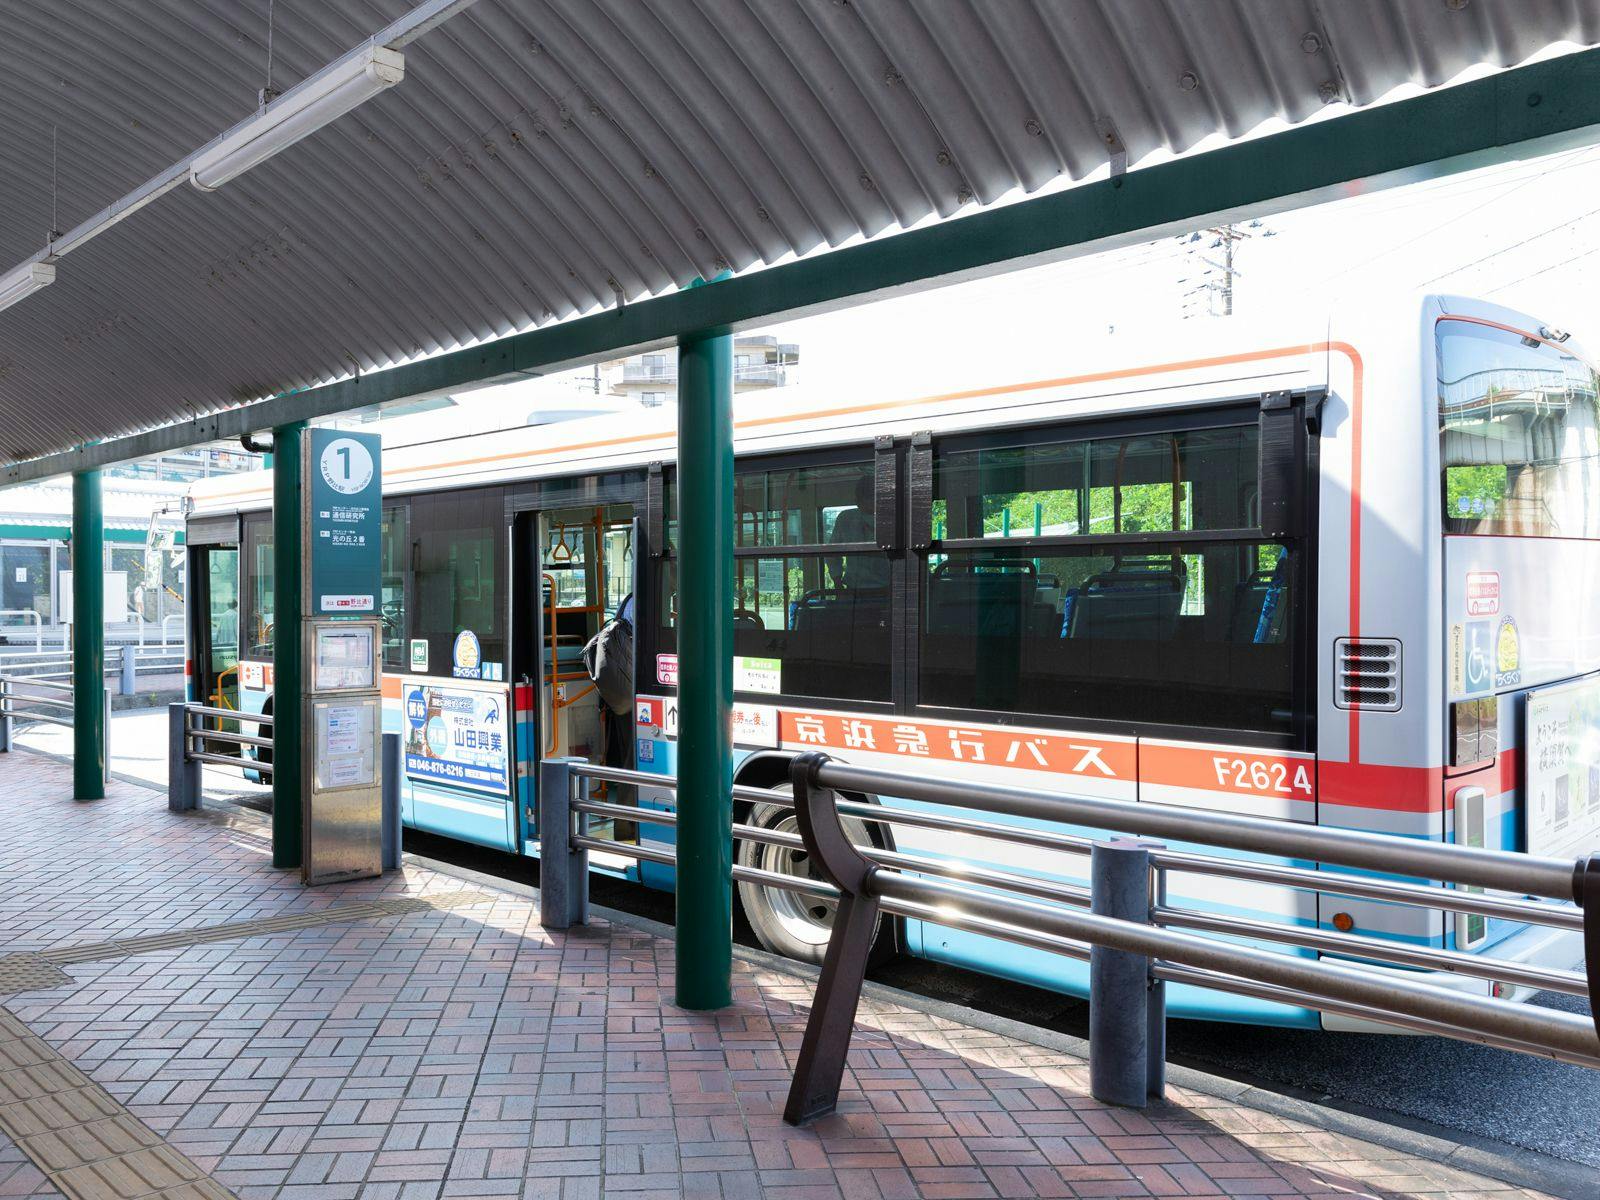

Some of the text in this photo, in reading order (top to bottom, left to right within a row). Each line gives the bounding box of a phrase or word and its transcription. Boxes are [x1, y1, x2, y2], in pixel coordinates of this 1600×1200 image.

[336, 447, 350, 480] 1
[332, 511, 366, 520] 通信研究所
[454, 727, 502, 752] 山田興業
[794, 714, 1118, 777] 京浜急行バス
[1213, 757, 1313, 796] F2624
